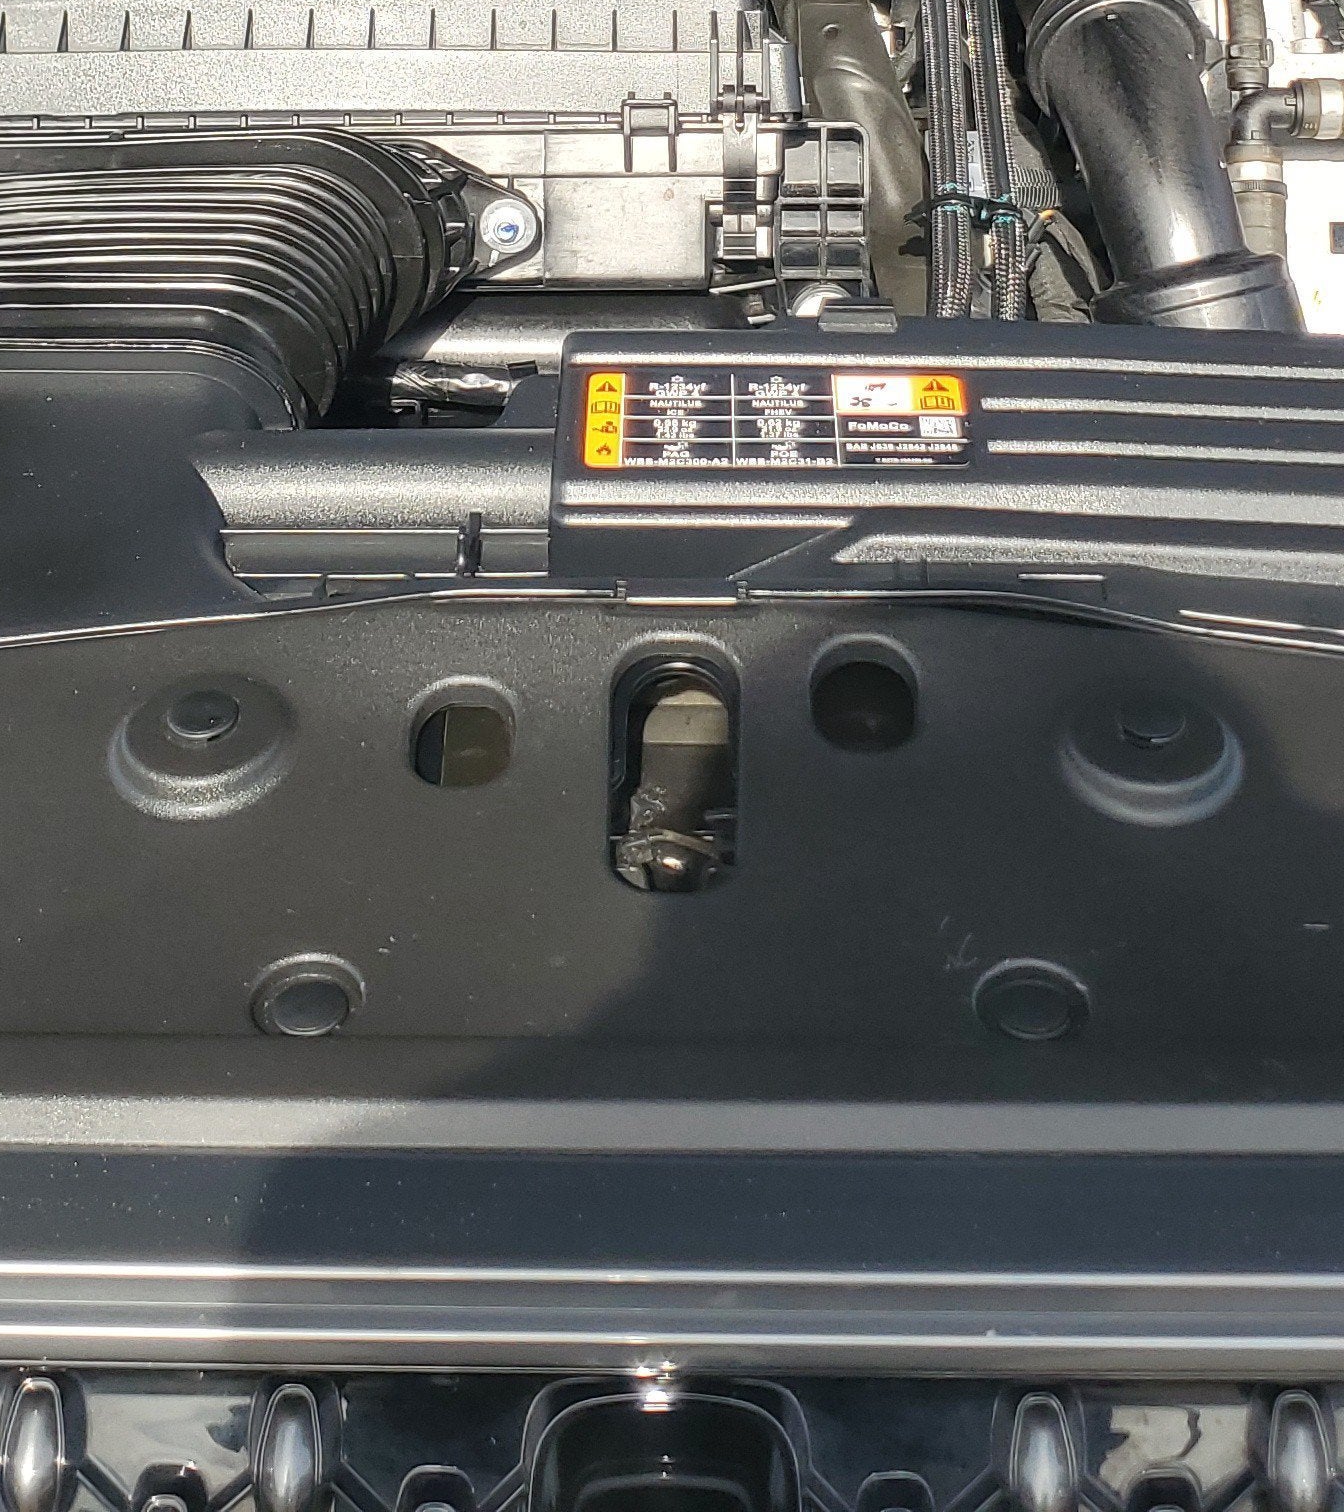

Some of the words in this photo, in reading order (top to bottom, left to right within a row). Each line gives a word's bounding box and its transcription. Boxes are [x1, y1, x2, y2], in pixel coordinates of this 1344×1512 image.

[649, 399, 702, 408] NAUTILUS
[752, 399, 804, 408] NAUTILUS
[847, 421, 910, 432] FoMoCo
